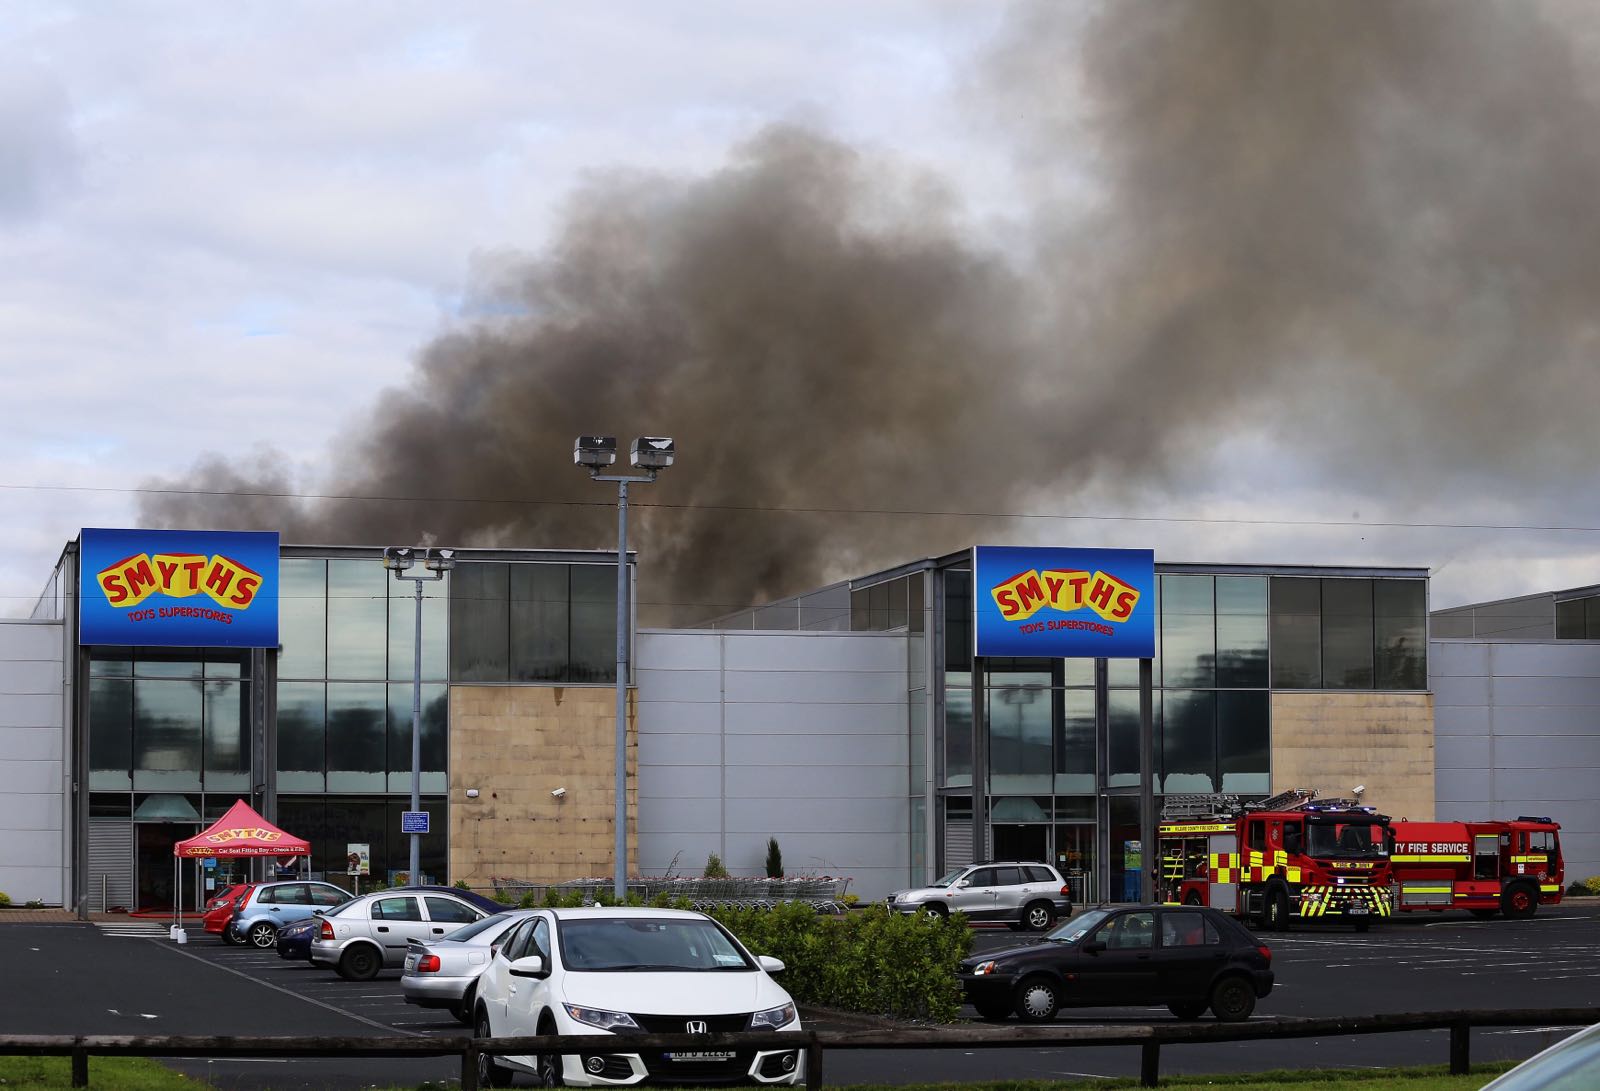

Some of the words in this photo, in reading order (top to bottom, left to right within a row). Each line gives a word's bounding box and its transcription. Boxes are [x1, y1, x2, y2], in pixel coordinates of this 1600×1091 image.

[102, 559, 258, 605] SMYTHS
[996, 575, 1137, 618] SMYTHS
[127, 608, 156, 623] TOYS
[158, 606, 233, 624] SUPERSTORES
[1019, 621, 1045, 635] TOYS
[1047, 620, 1114, 636] SUPERSTORES
[208, 828, 279, 842] SMYTHS
[1408, 843, 1428, 853] FIRE
[1431, 843, 1469, 853] SERVICE
